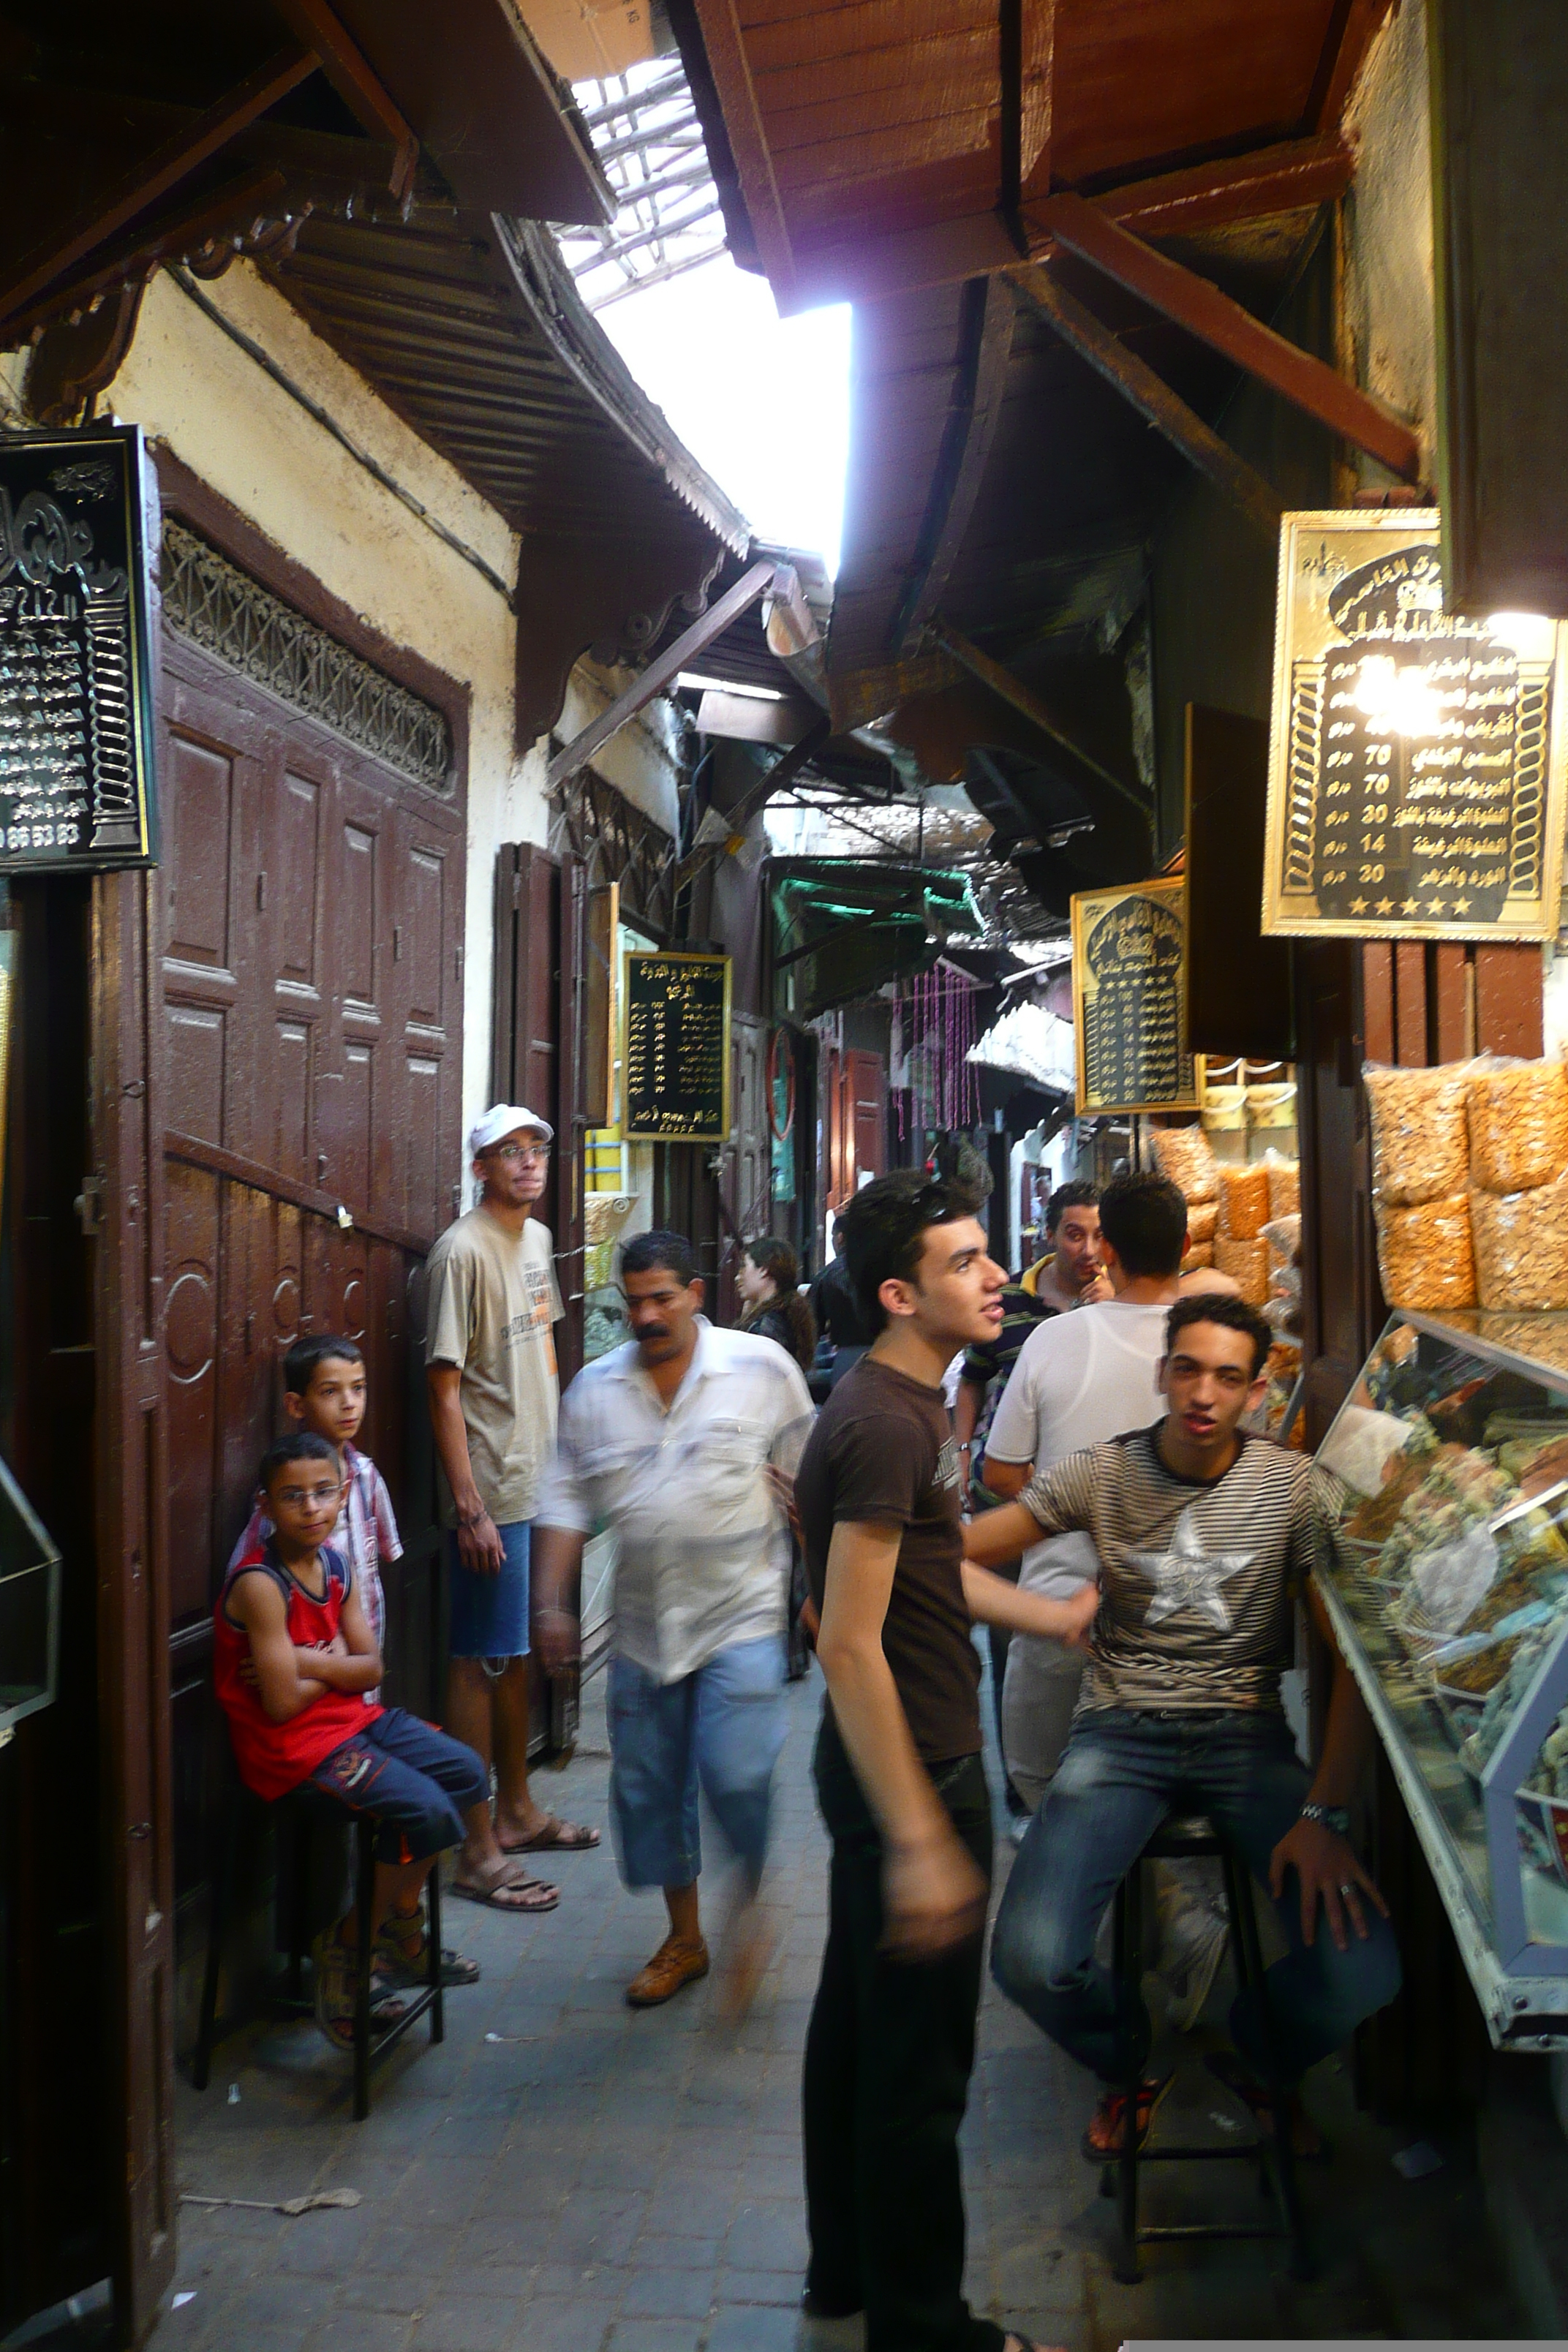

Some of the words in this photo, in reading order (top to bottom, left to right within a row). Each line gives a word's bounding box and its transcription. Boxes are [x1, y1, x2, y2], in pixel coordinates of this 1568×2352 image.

[1364, 745, 1392, 766] 70
[1363, 774, 1390, 795] 70
[1360, 834, 1386, 853] 14
